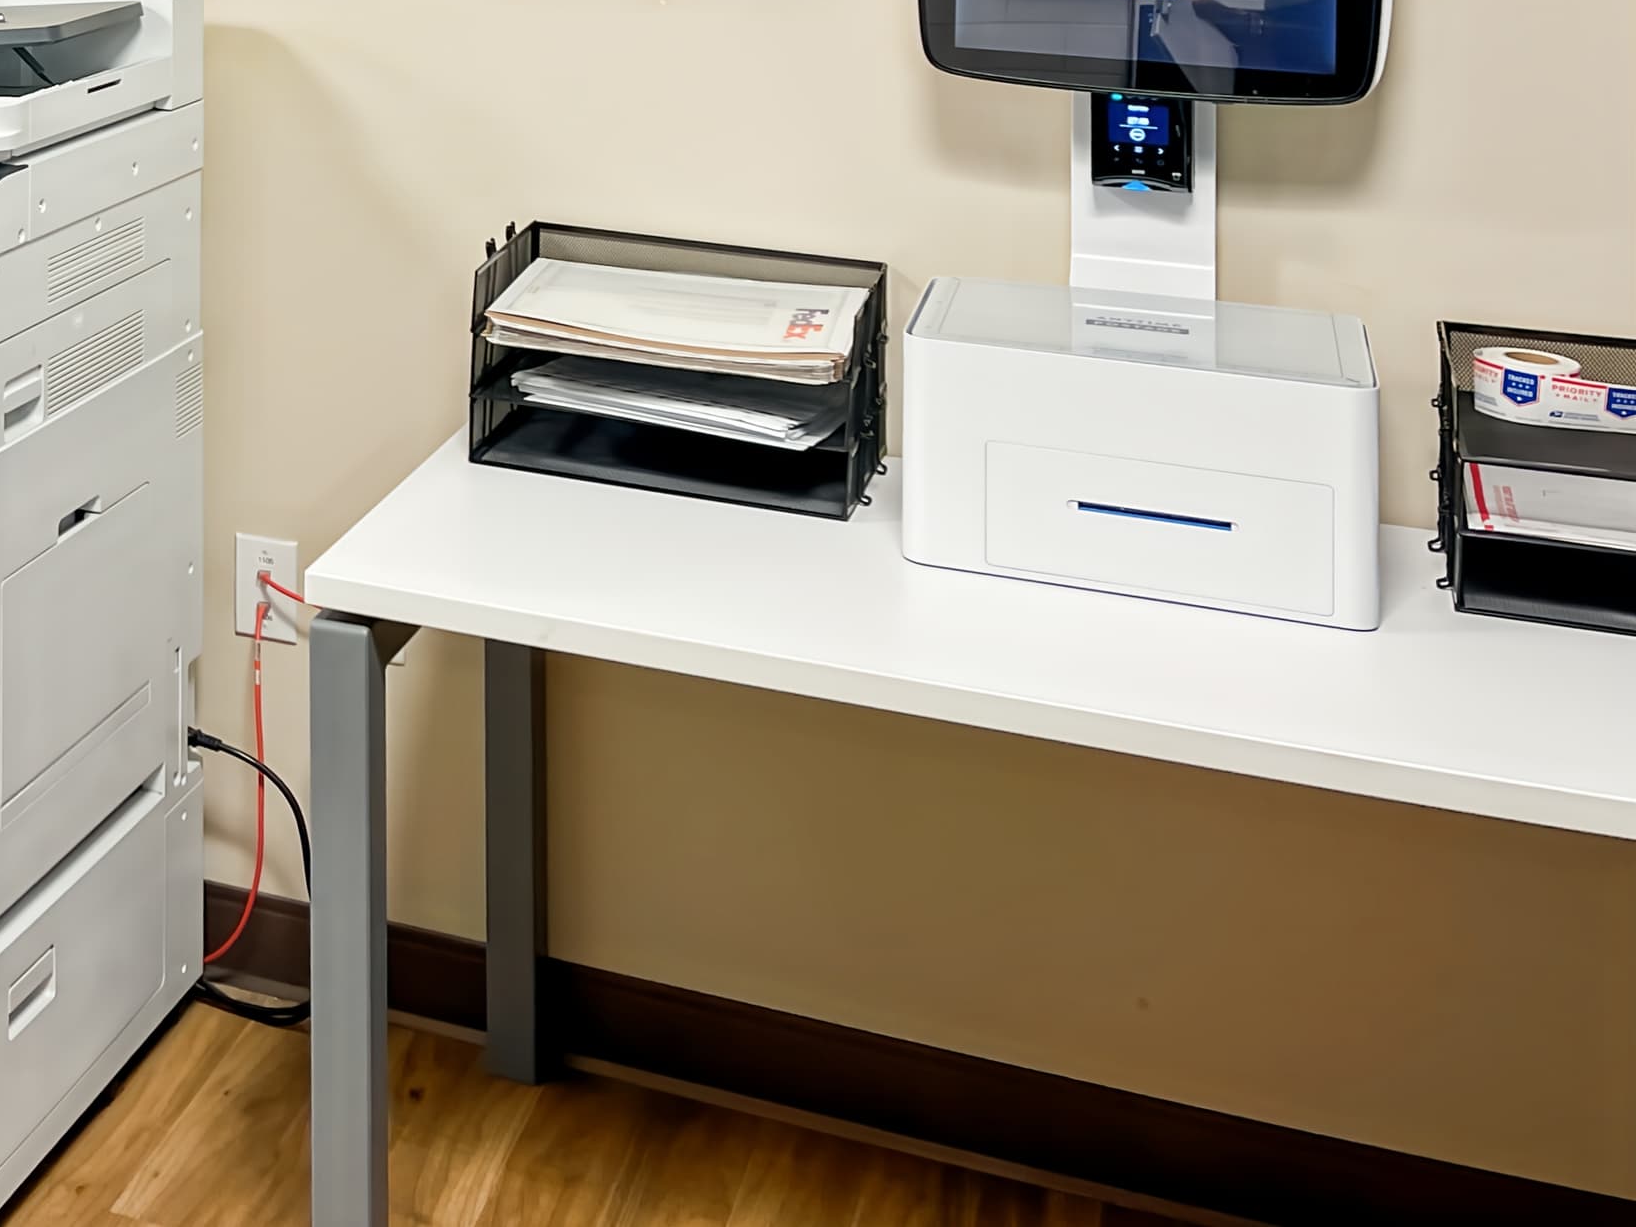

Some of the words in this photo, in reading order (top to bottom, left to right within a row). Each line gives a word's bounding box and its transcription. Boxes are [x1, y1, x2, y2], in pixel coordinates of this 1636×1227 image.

[784, 308, 829, 339] FedEx
[1552, 384, 1602, 396] PRIORITY
[1564, 394, 1589, 402] MAIL
